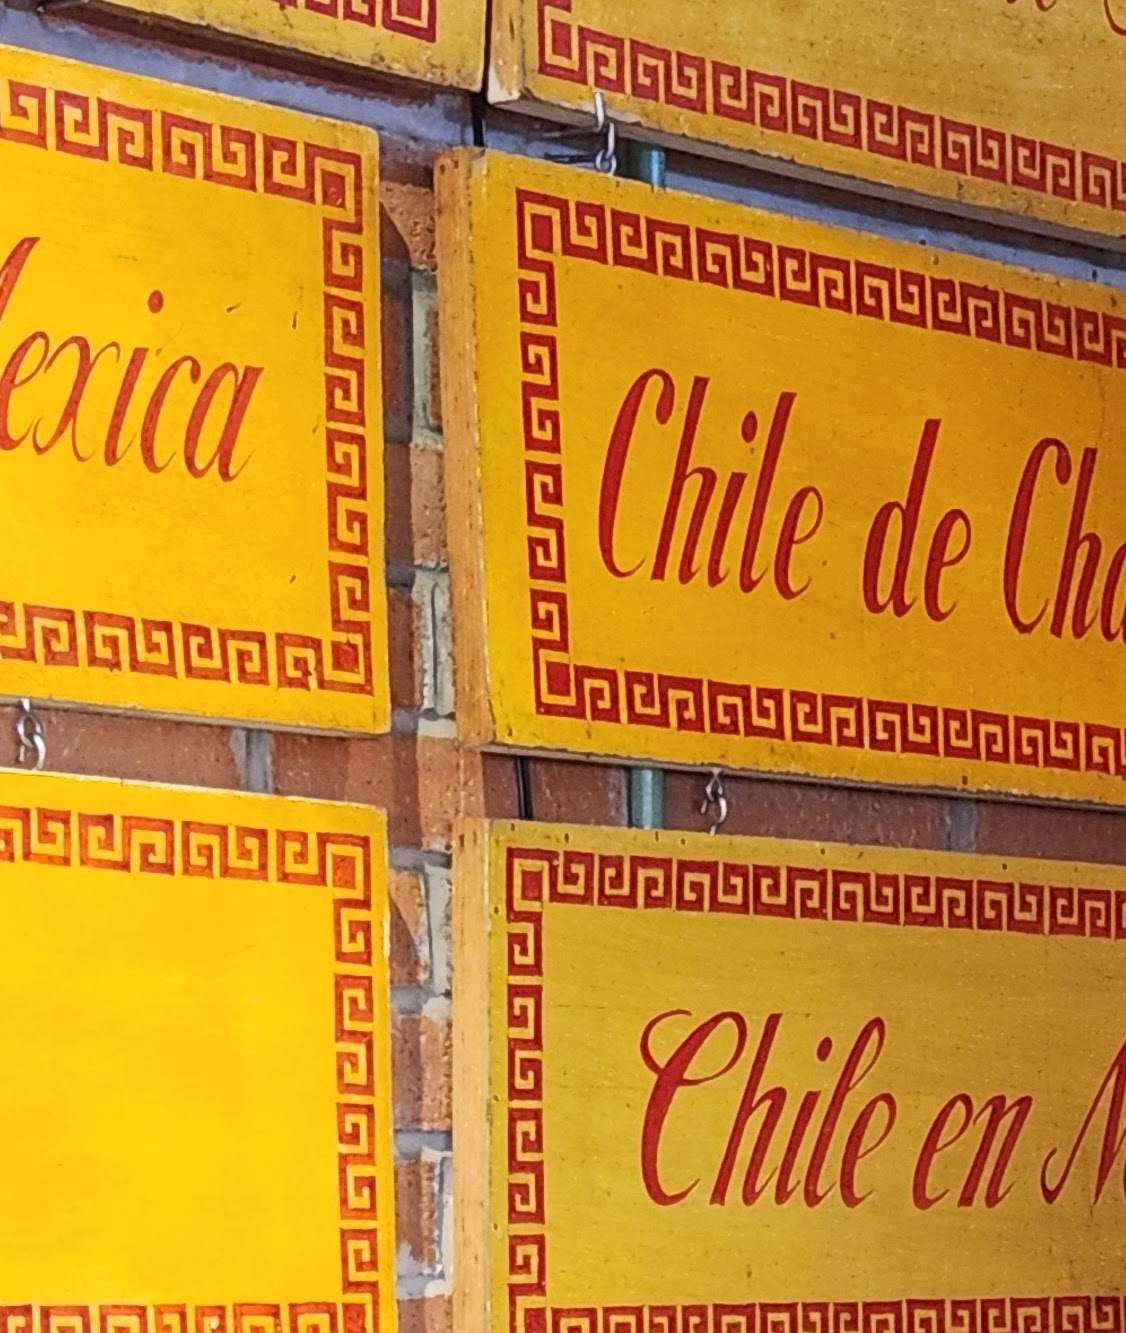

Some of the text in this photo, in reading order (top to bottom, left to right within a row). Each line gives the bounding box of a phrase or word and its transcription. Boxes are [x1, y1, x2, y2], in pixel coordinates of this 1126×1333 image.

[0, 237, 263, 482] exica
[598, 368, 823, 600] Chile
[863, 418, 971, 622] de
[640, 1010, 896, 1208] Chile
[912, 1093, 1033, 1210] en
